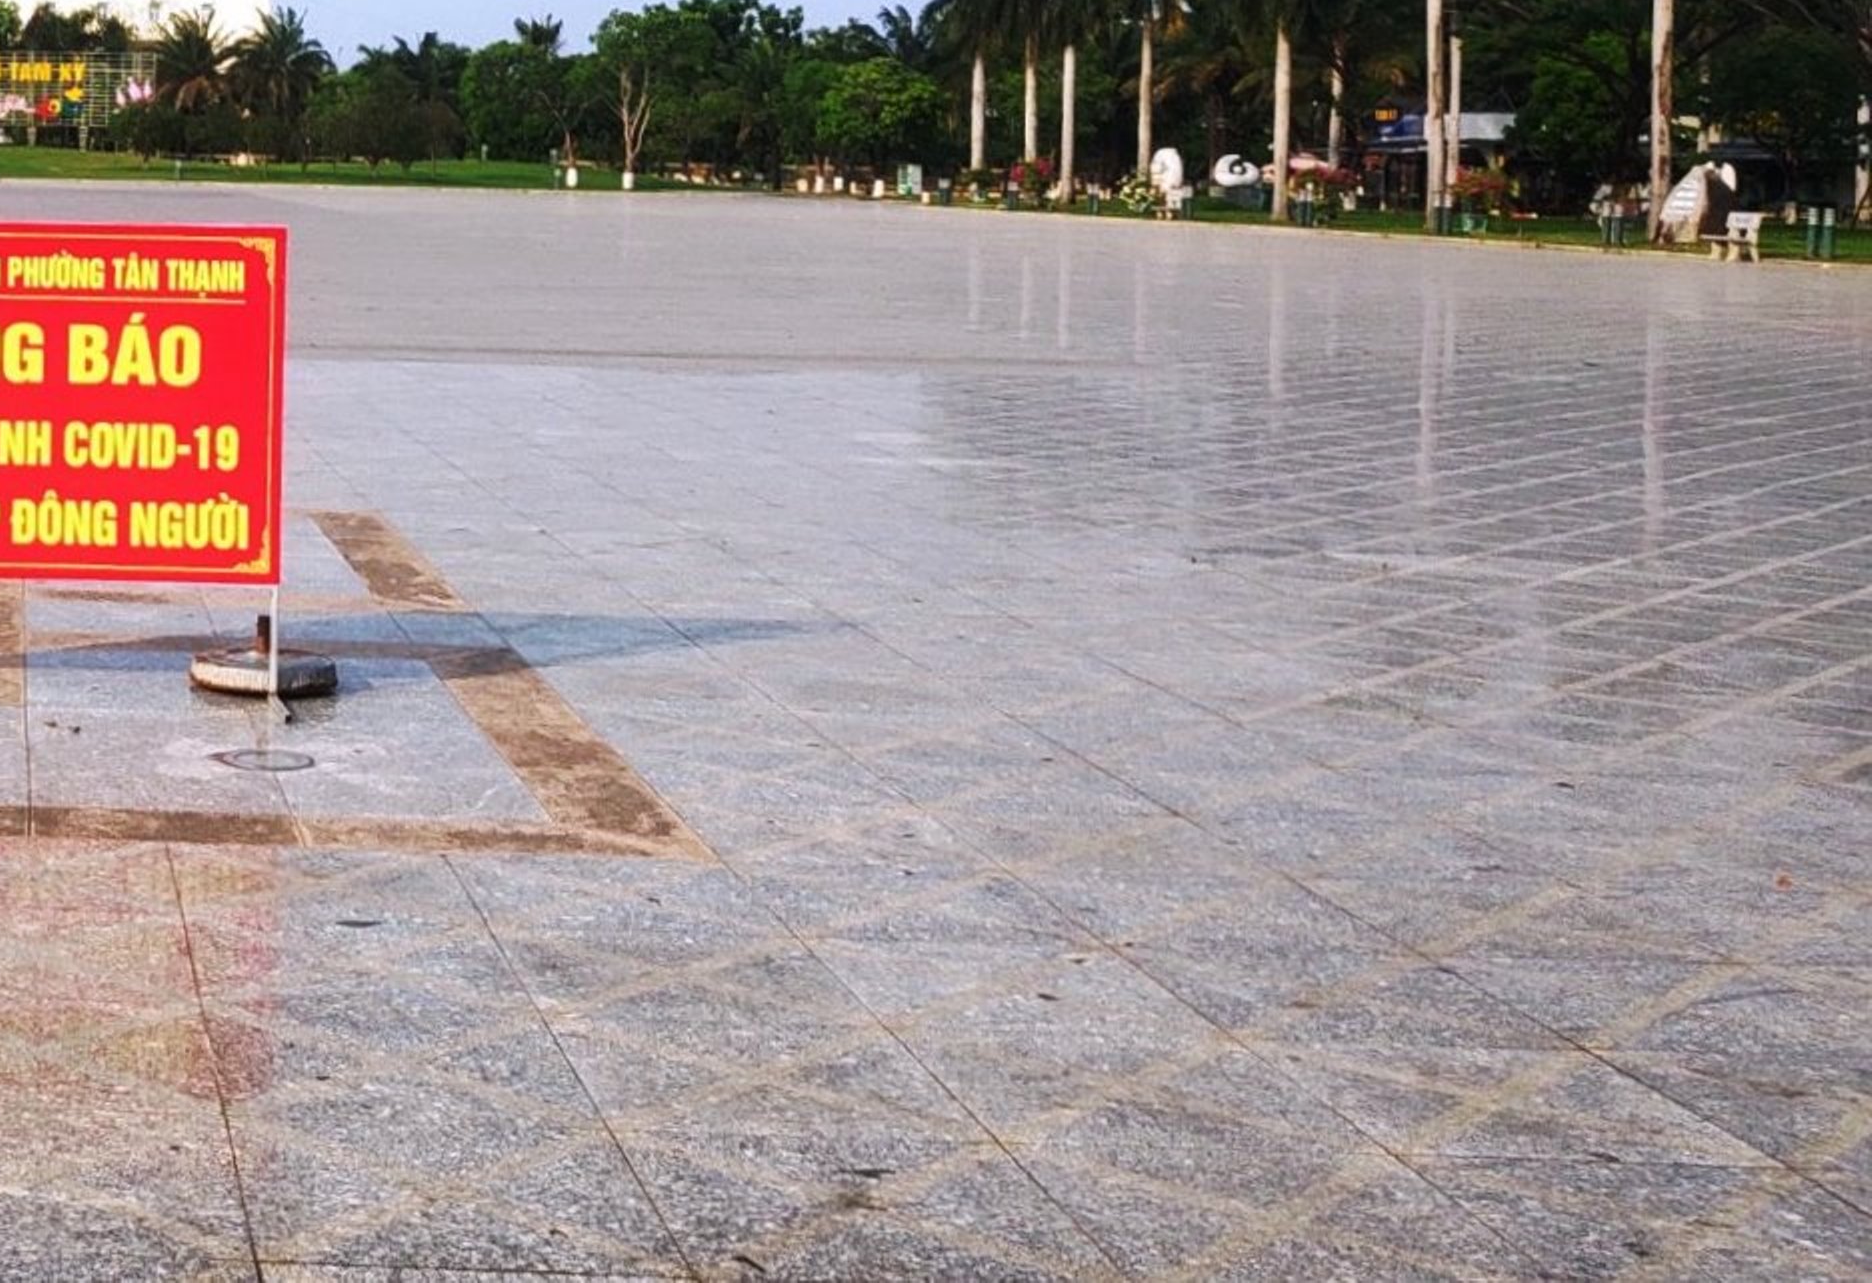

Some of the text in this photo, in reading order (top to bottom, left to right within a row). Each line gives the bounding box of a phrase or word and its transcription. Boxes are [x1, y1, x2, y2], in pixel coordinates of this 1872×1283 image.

[7, 249, 106, 289] PHƯỜNG
[112, 251, 160, 291] TÂN
[165, 258, 246, 300] THẠNH
[68, 311, 202, 388] BÁO
[64, 421, 240, 472] COVID-19
[10, 490, 118, 547] ĐÔNG
[130, 492, 250, 551] NGƯỜI
